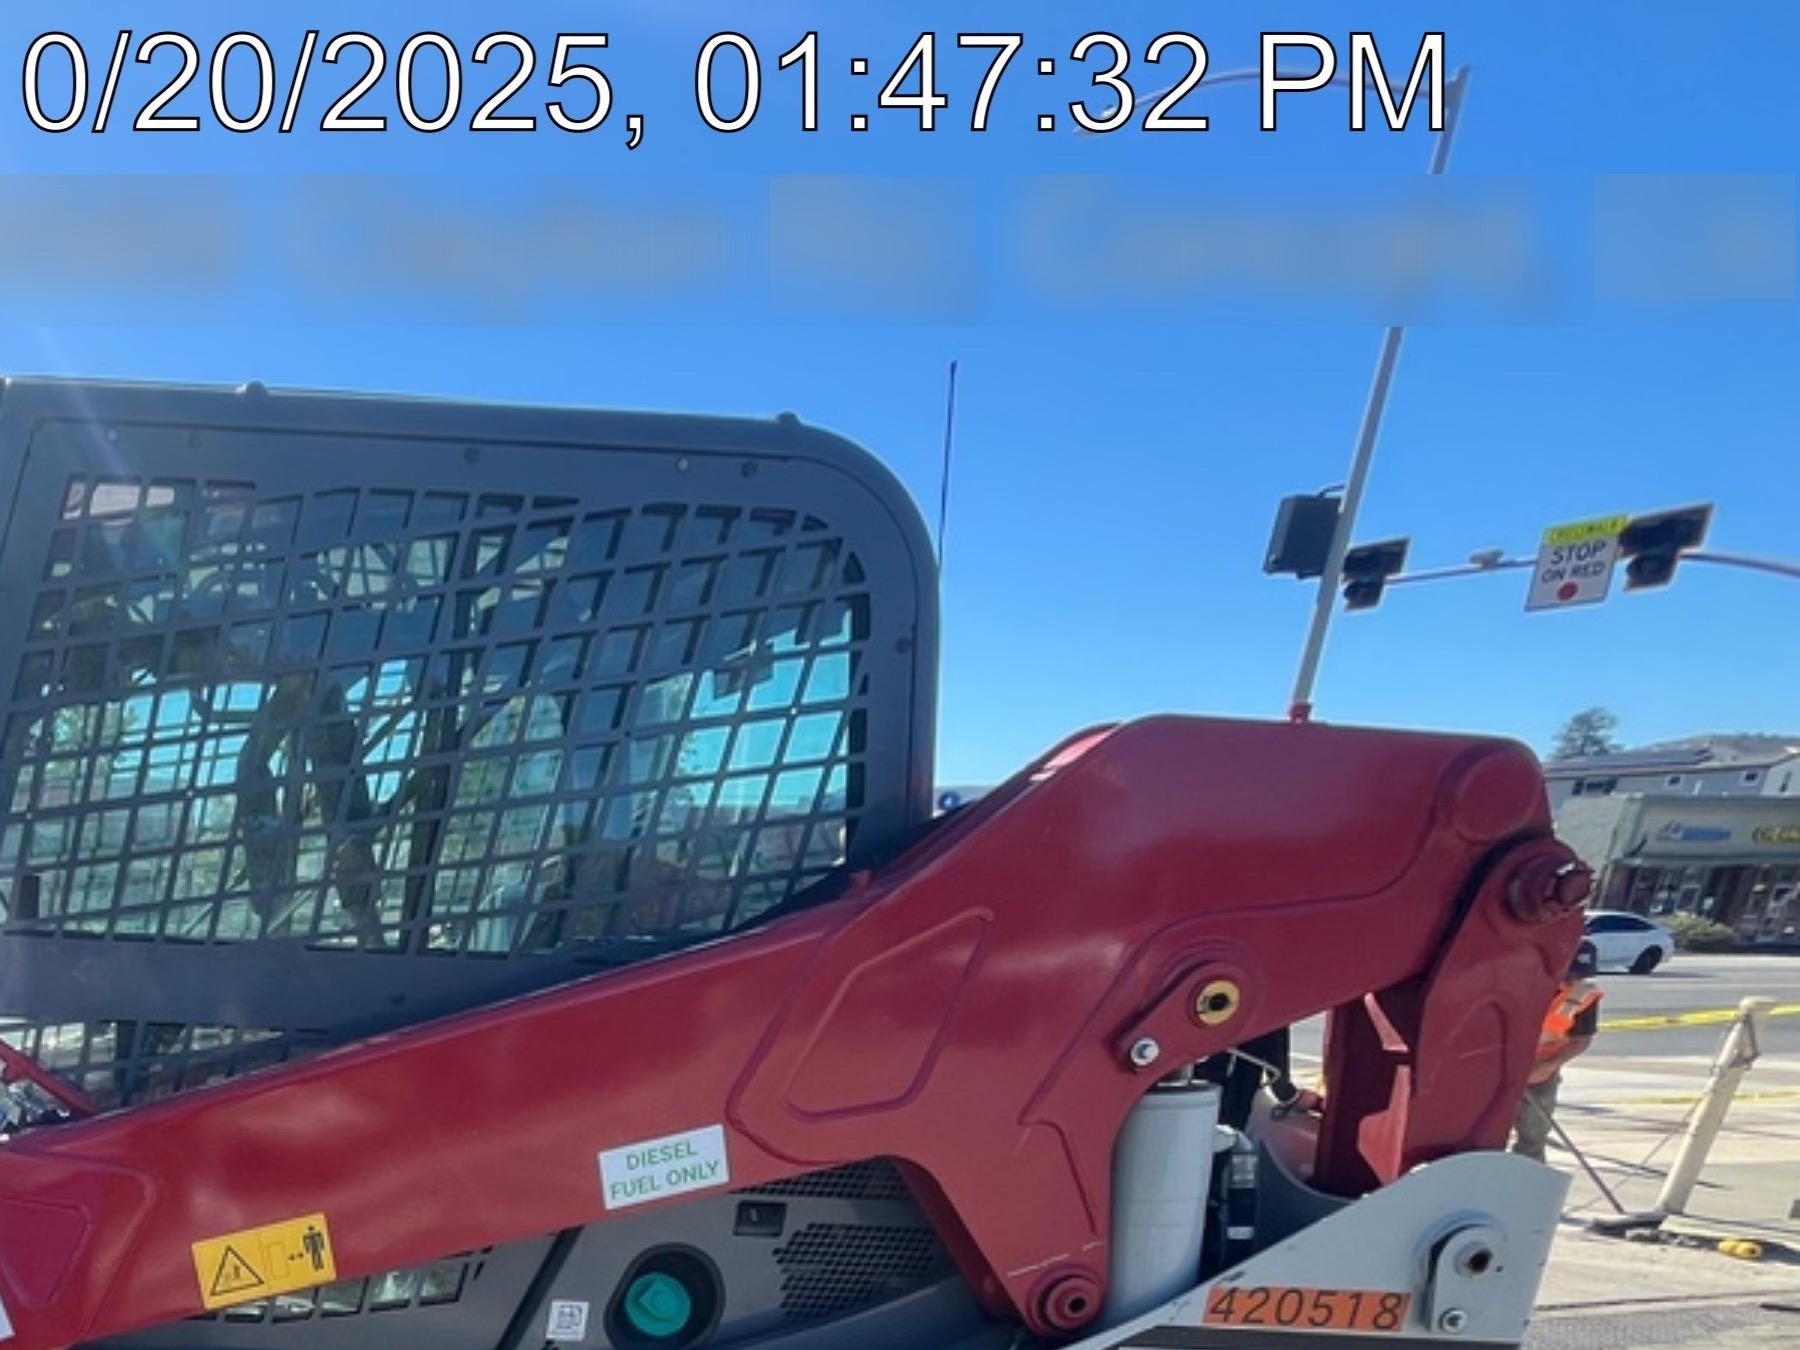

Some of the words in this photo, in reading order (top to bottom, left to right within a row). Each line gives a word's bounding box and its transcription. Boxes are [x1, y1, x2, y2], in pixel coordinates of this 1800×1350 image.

[1550, 540, 1607, 565] STOP
[1541, 567, 1567, 583] ON
[1570, 561, 1605, 578] RED
[626, 1141, 698, 1171] DIESEL
[610, 1175, 661, 1200] FUEL
[665, 1160, 719, 1185] ONLY
[1208, 1291, 1401, 1330] 420518
